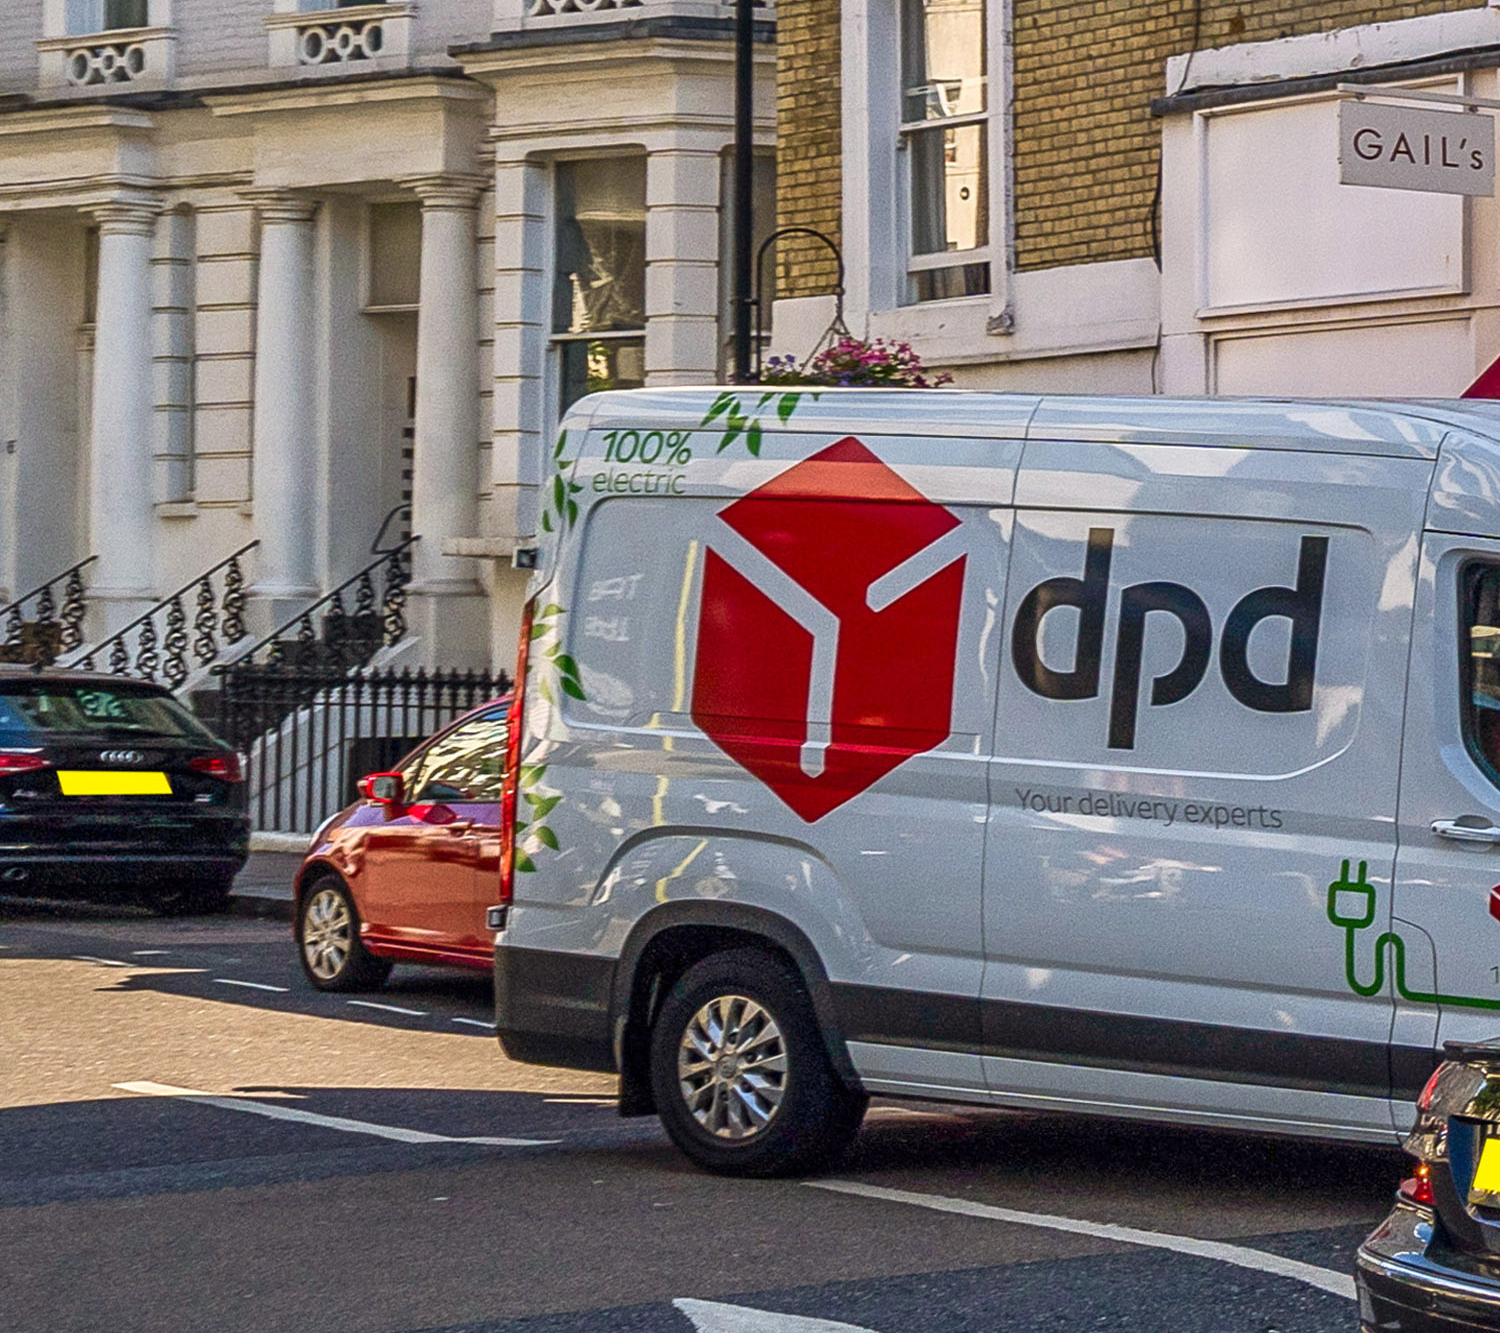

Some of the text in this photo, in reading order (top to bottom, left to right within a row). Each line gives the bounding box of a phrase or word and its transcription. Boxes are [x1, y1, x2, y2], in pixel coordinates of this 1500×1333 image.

[1353, 128, 1484, 171] GAIL's
[602, 430, 693, 466] 100%
[592, 467, 687, 495] electric
[1010, 527, 1330, 750] dpd
[1014, 787, 1284, 829] Your delivery experts
